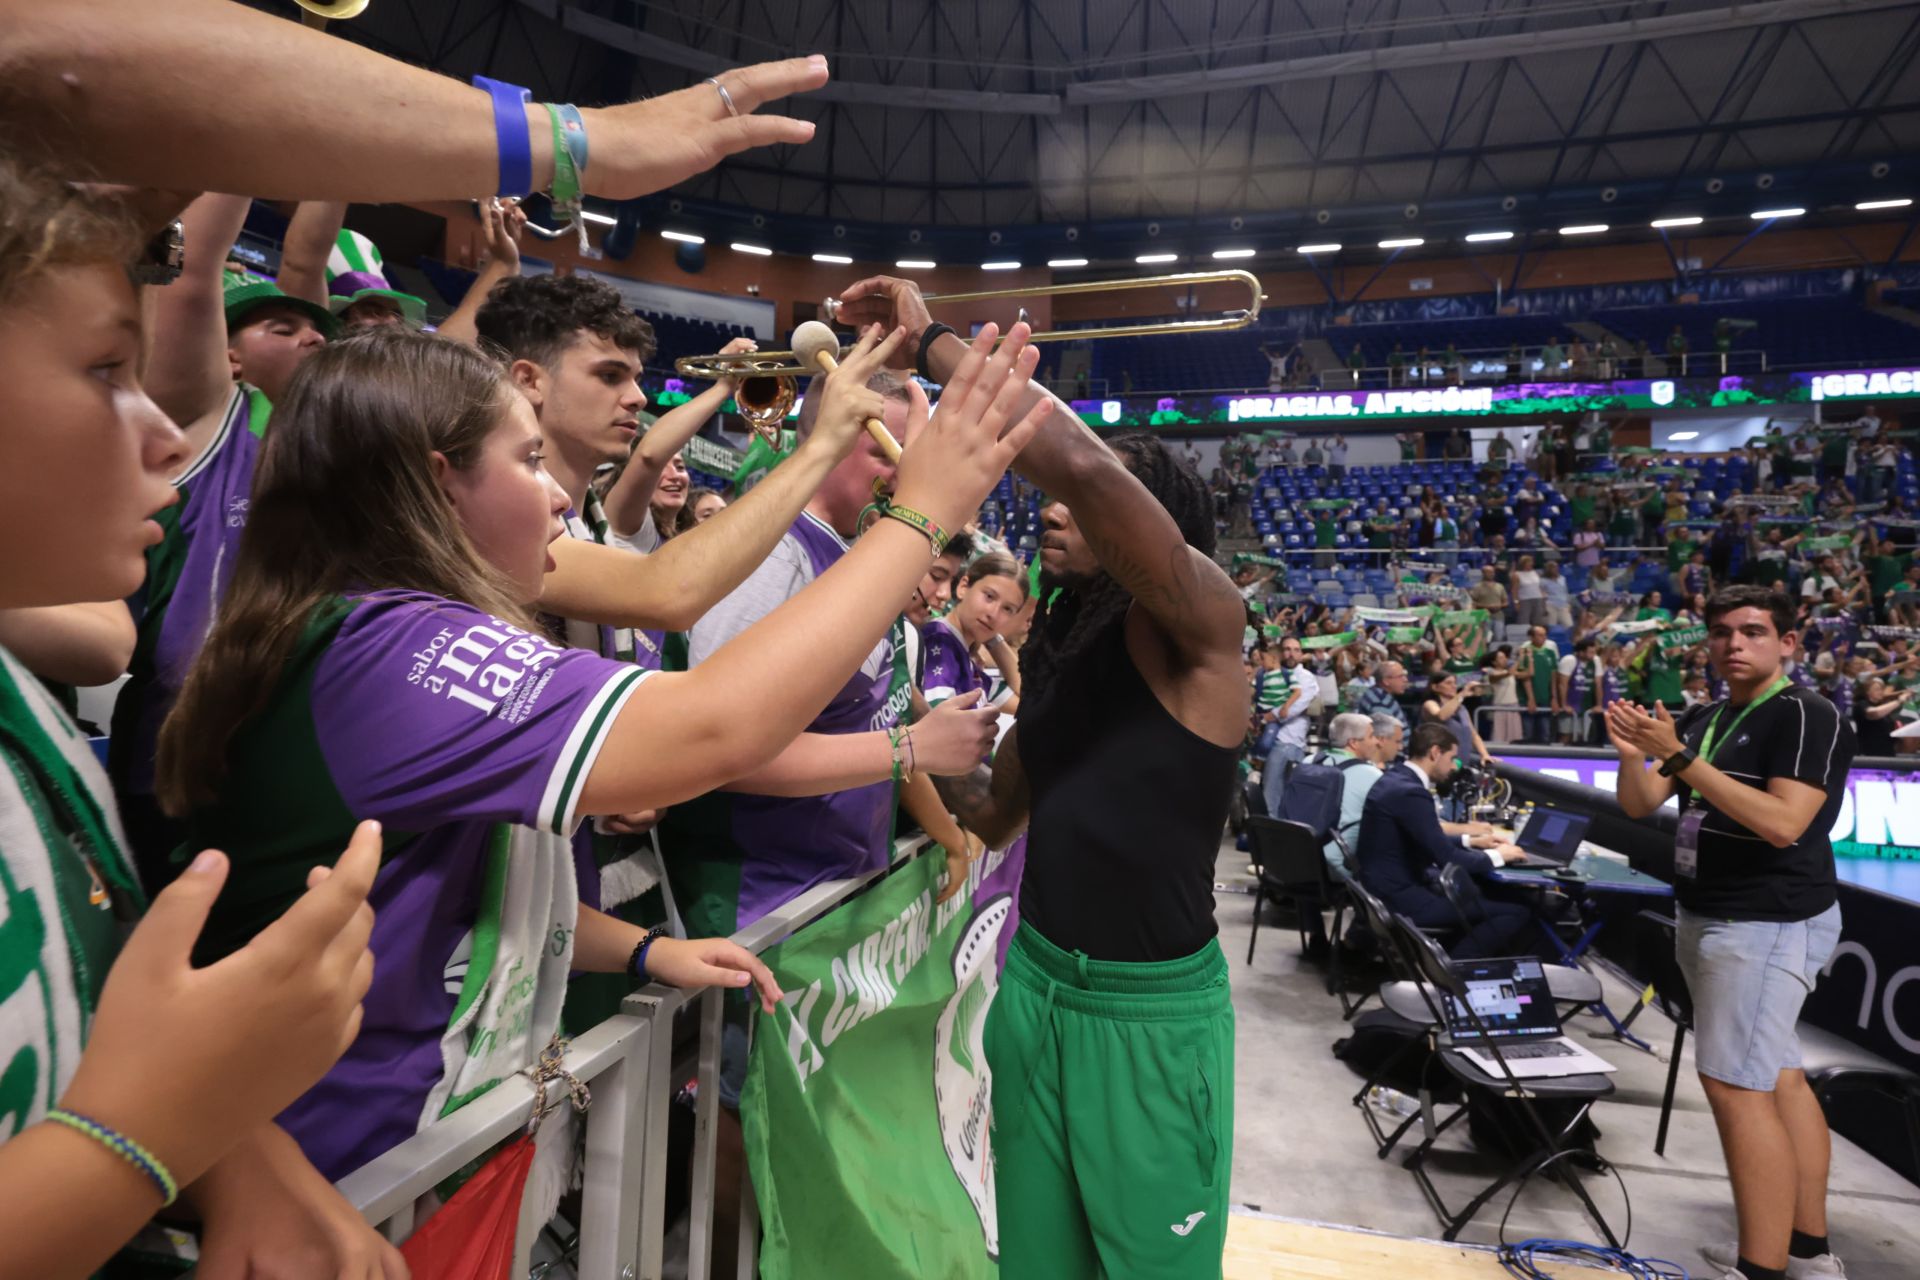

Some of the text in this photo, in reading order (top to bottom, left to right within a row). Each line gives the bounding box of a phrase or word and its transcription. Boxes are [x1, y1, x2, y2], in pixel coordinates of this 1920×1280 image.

[1228, 386, 1493, 421] ¡GRACIAS, AFICIÓN!
[407, 627, 454, 685] sabor
[423, 674, 448, 694] a
